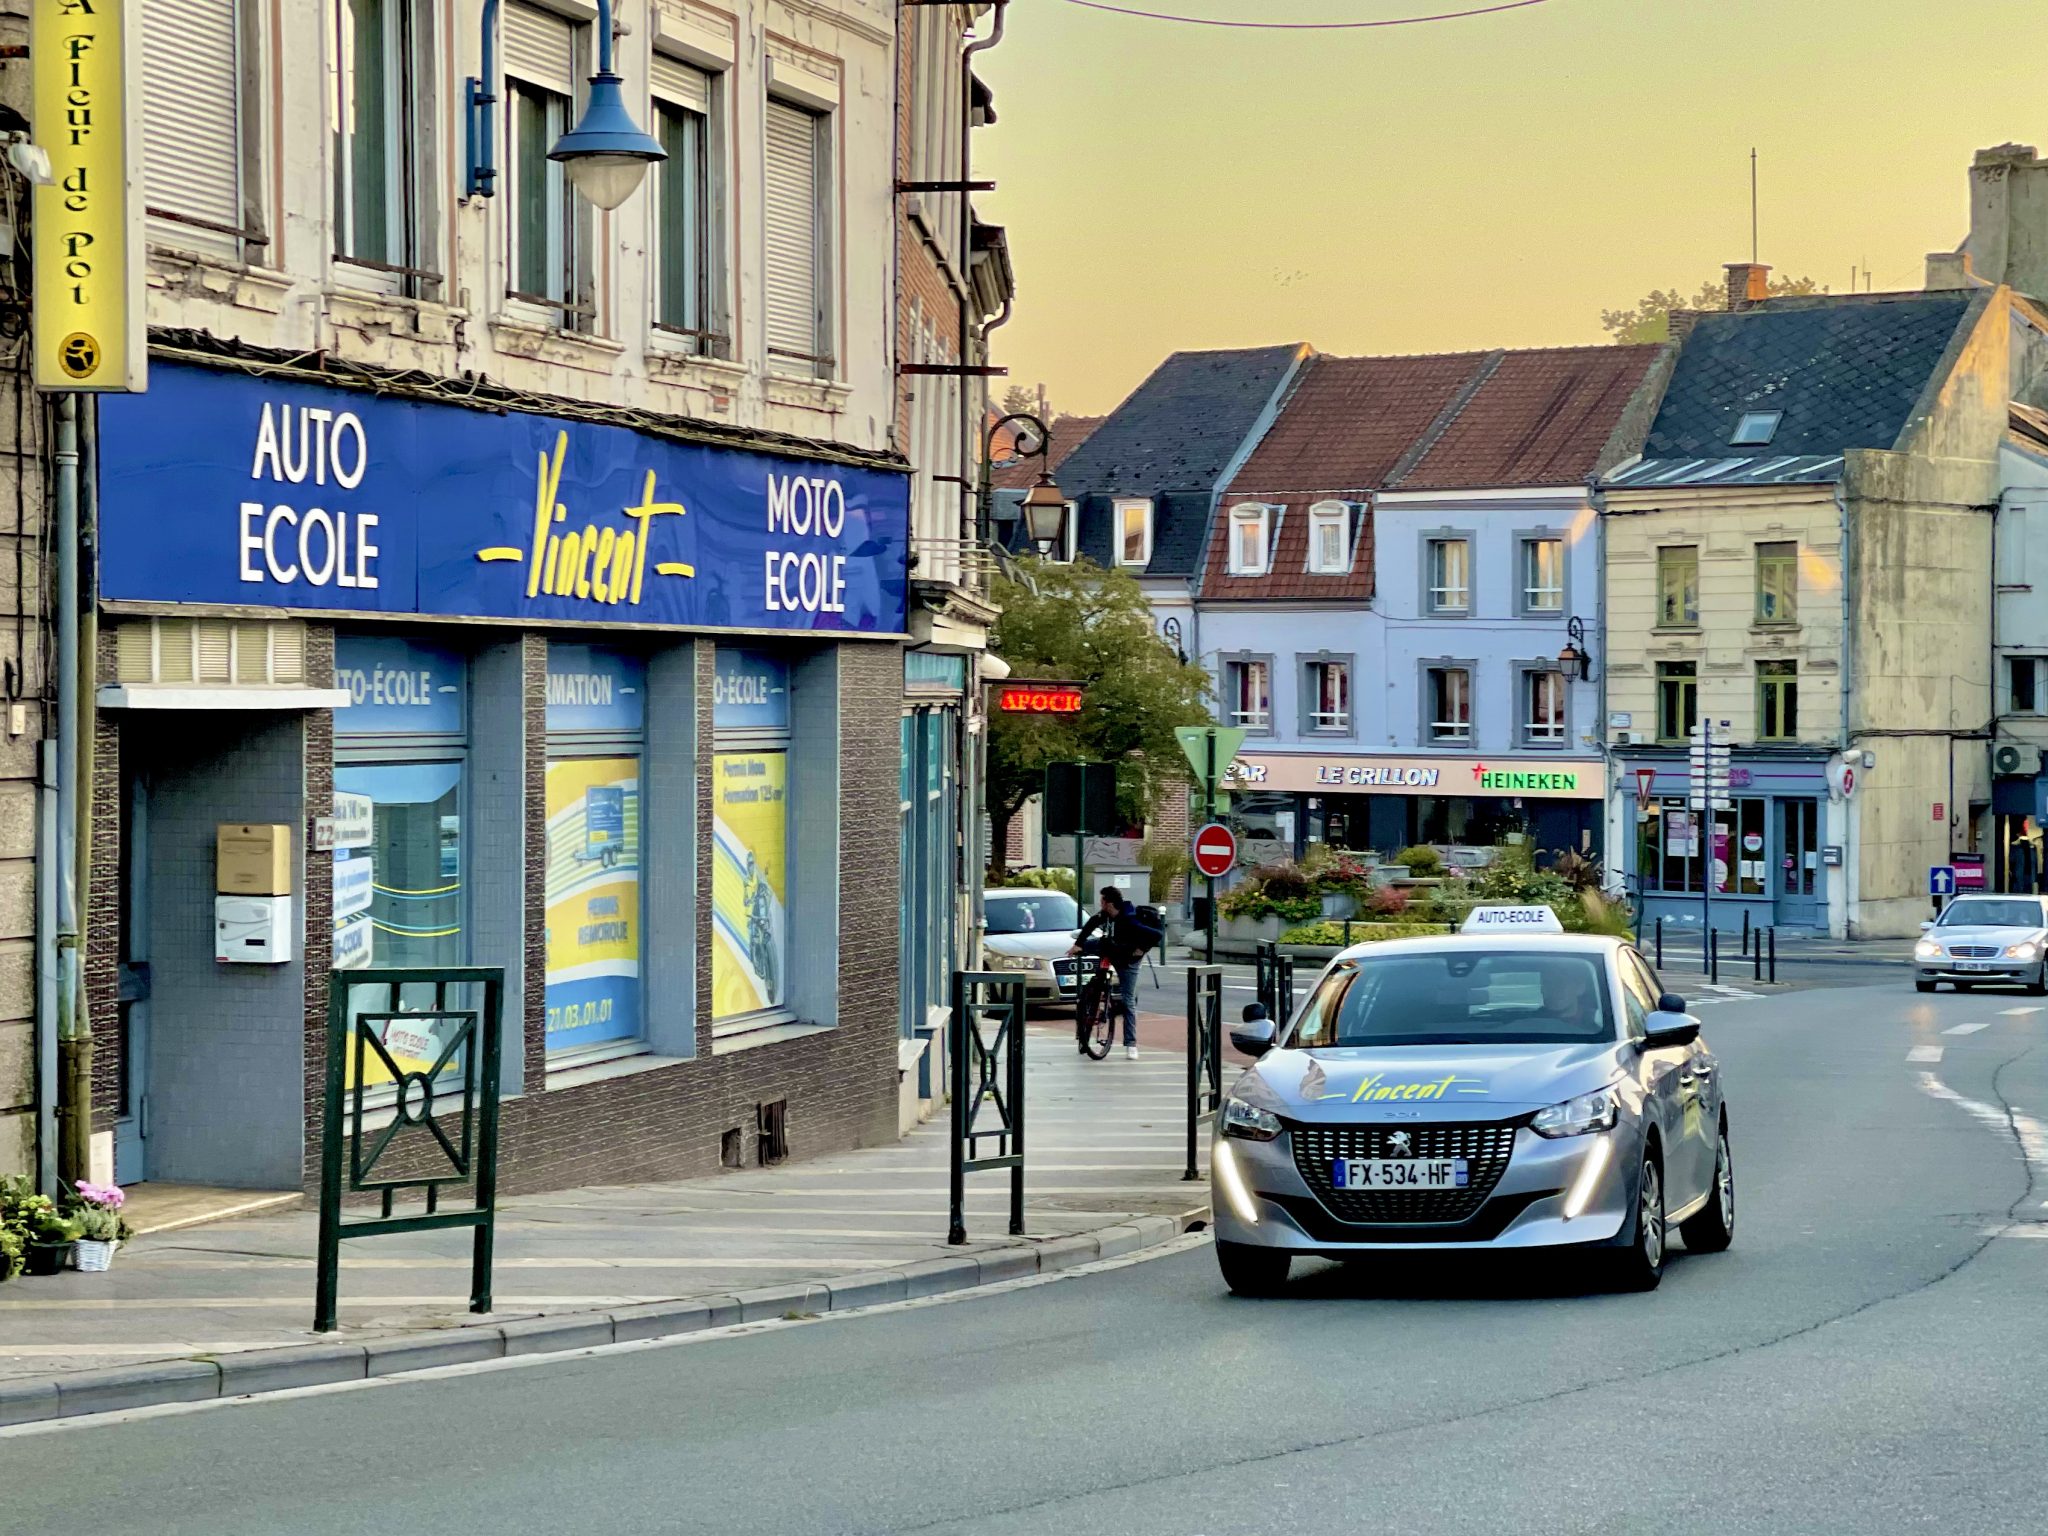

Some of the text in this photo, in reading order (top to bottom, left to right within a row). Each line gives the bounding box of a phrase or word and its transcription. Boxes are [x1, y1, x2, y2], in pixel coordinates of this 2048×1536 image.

[61, 34, 96, 146] Fleur
[62, 167, 90, 212] de
[60, 231, 95, 305] Pot
[251, 401, 368, 490] AUTO
[526, 429, 686, 605] Vincent
[767, 473, 845, 538] MOTO
[239, 501, 379, 589] ECOLE
[765, 550, 846, 613] ECOLE
[1315, 766, 1438, 787] LE GRILLON
[1481, 772, 1575, 790] HEINEKEN
[317, 825, 334, 846] 22
[1478, 910, 1545, 923] AUTO-ECOLE
[1351, 1073, 1482, 1104] Vincent
[1348, 1163, 1453, 1186] FX-534-HF
